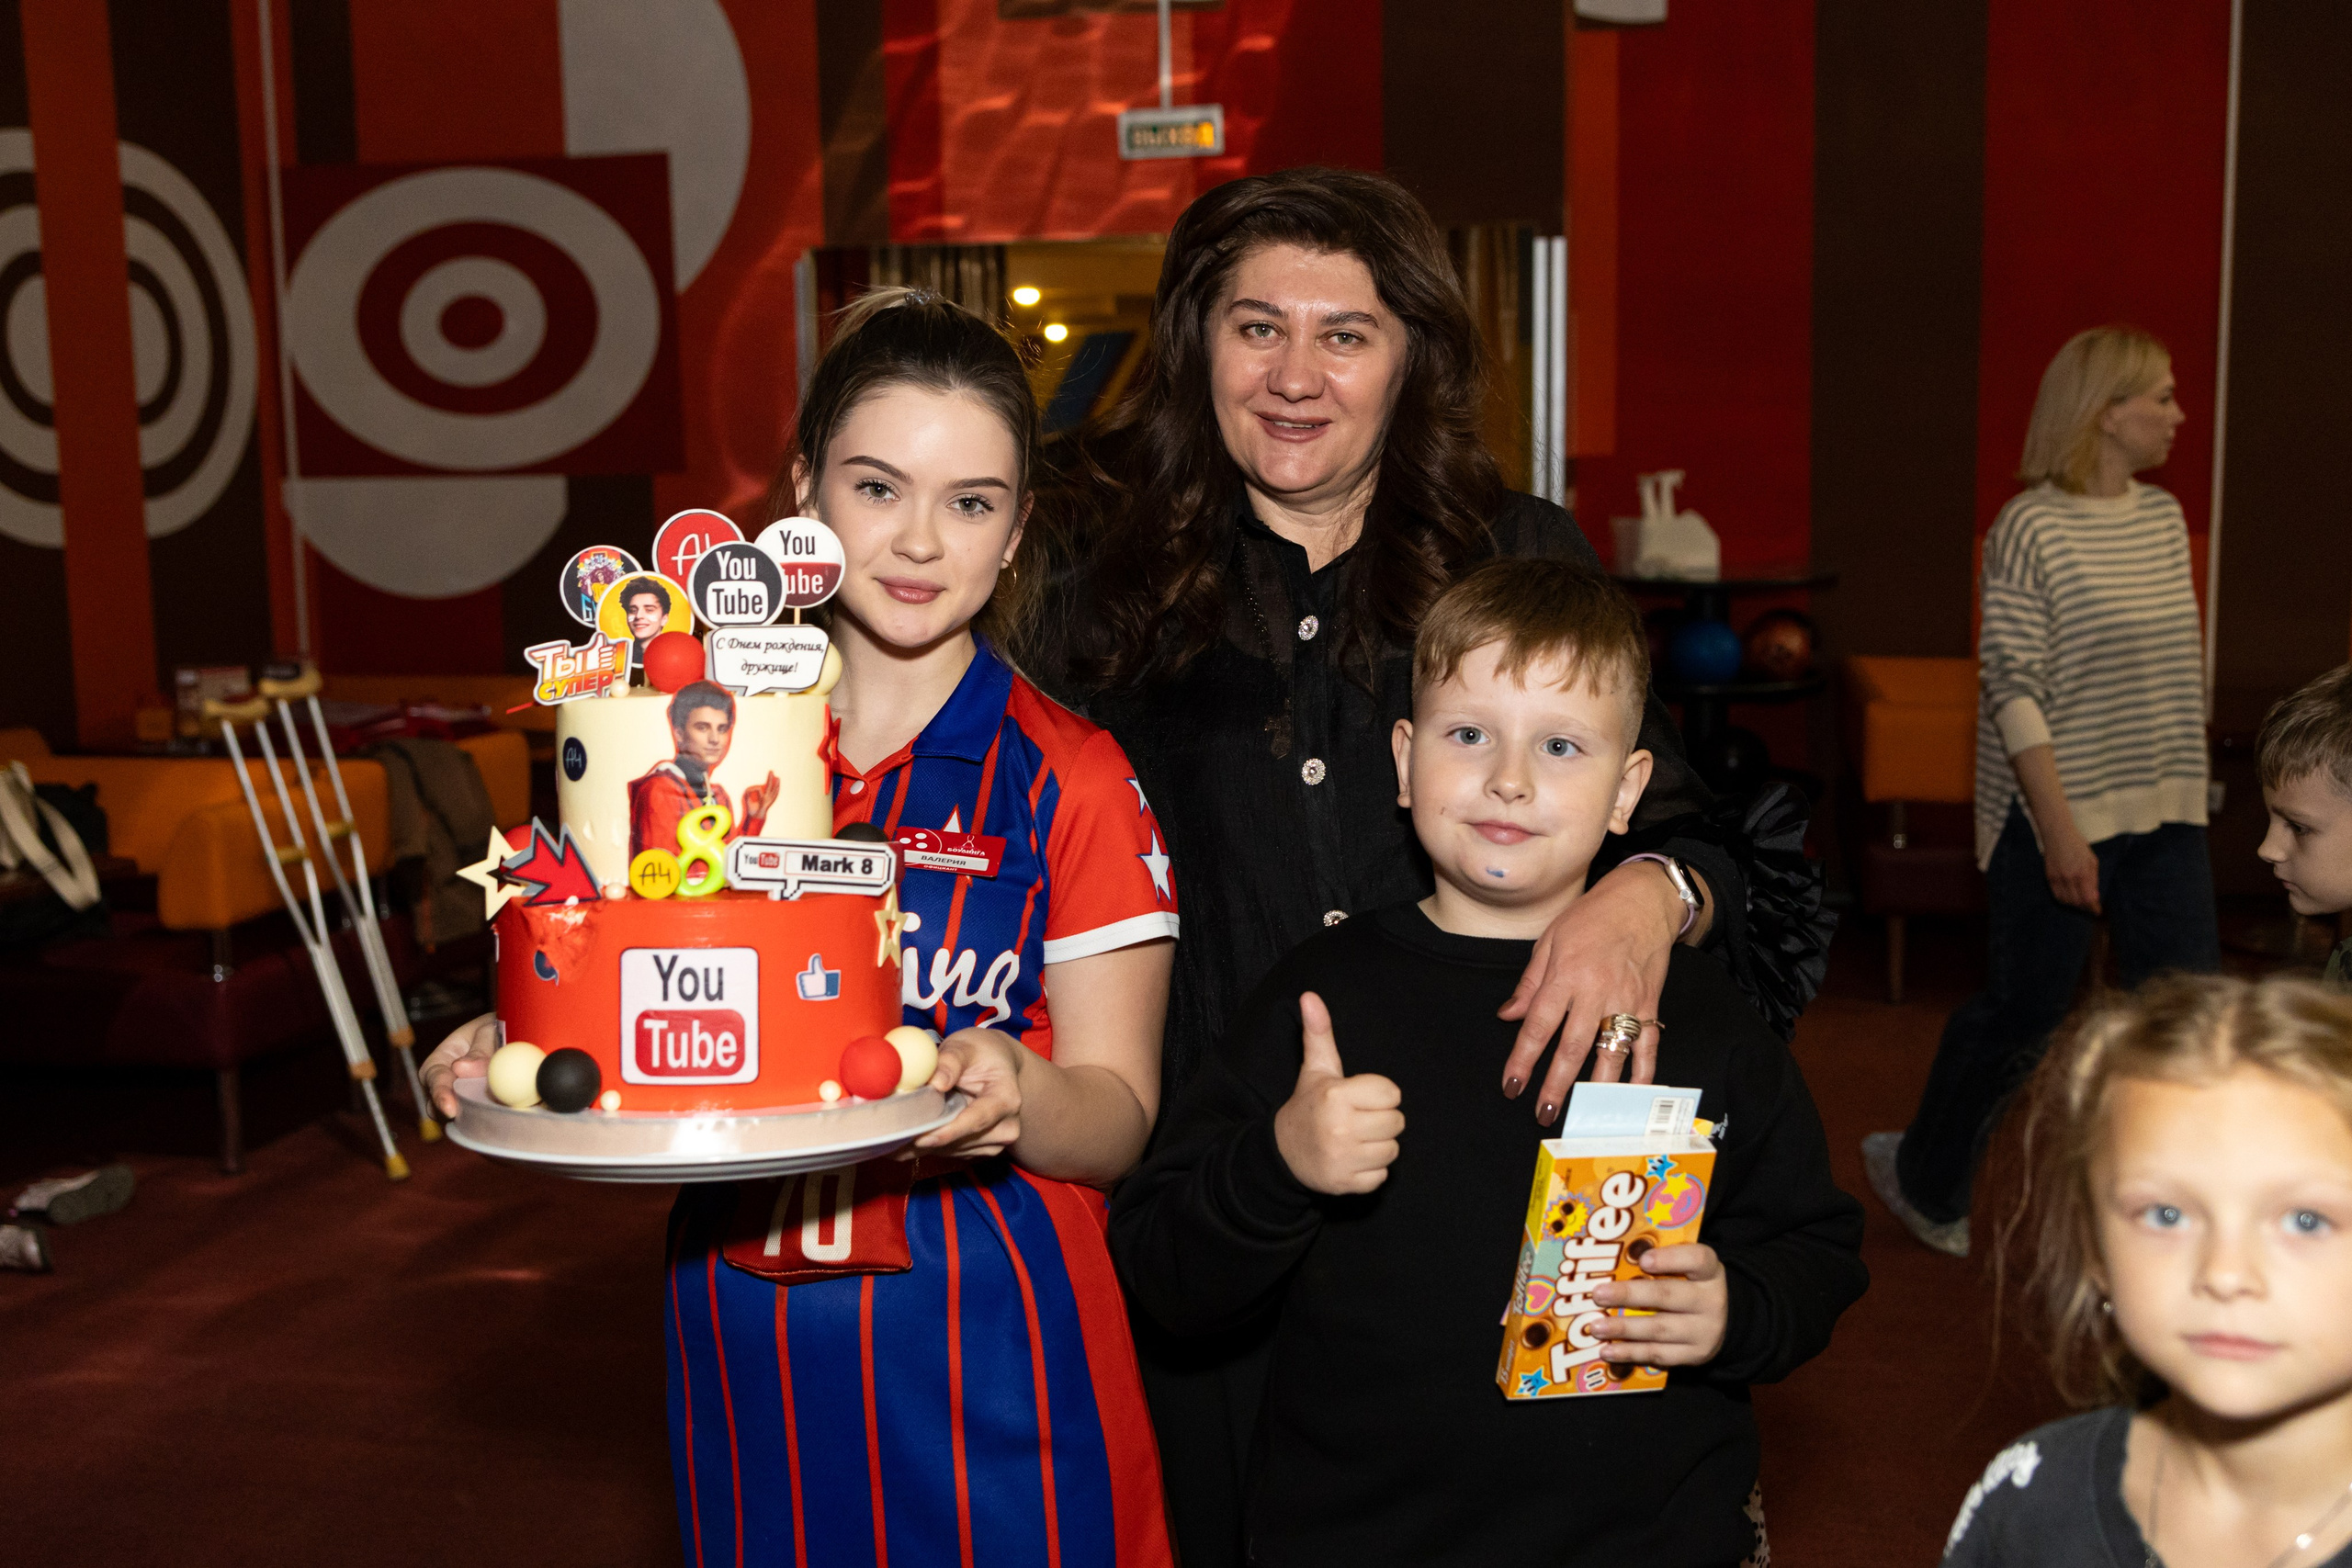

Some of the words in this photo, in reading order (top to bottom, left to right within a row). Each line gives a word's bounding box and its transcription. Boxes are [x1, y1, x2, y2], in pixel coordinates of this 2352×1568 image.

[779, 530, 816, 556] You
[716, 551, 757, 580] You
[783, 568, 824, 595] ube
[712, 588, 763, 615] Tube
[716, 637, 726, 650] С
[728, 637, 762, 649] Днем
[763, 637, 824, 654] рождения,
[741, 658, 799, 676] дружище!
[676, 805, 733, 897] 8
[921, 854, 967, 867] ВАЛЕРИЯ
[946, 846, 986, 857] БОУЛИНГА
[639, 862, 672, 886] A4
[801, 854, 854, 874] Mark
[861, 858, 874, 875] 8
[923, 864, 958, 873] ОФИЦИАНТ
[652, 954, 725, 1002] You
[901, 911, 1021, 1029] ing
[643, 1019, 738, 1069] Tube
[1549, 1170, 1647, 1384] Toffifee
